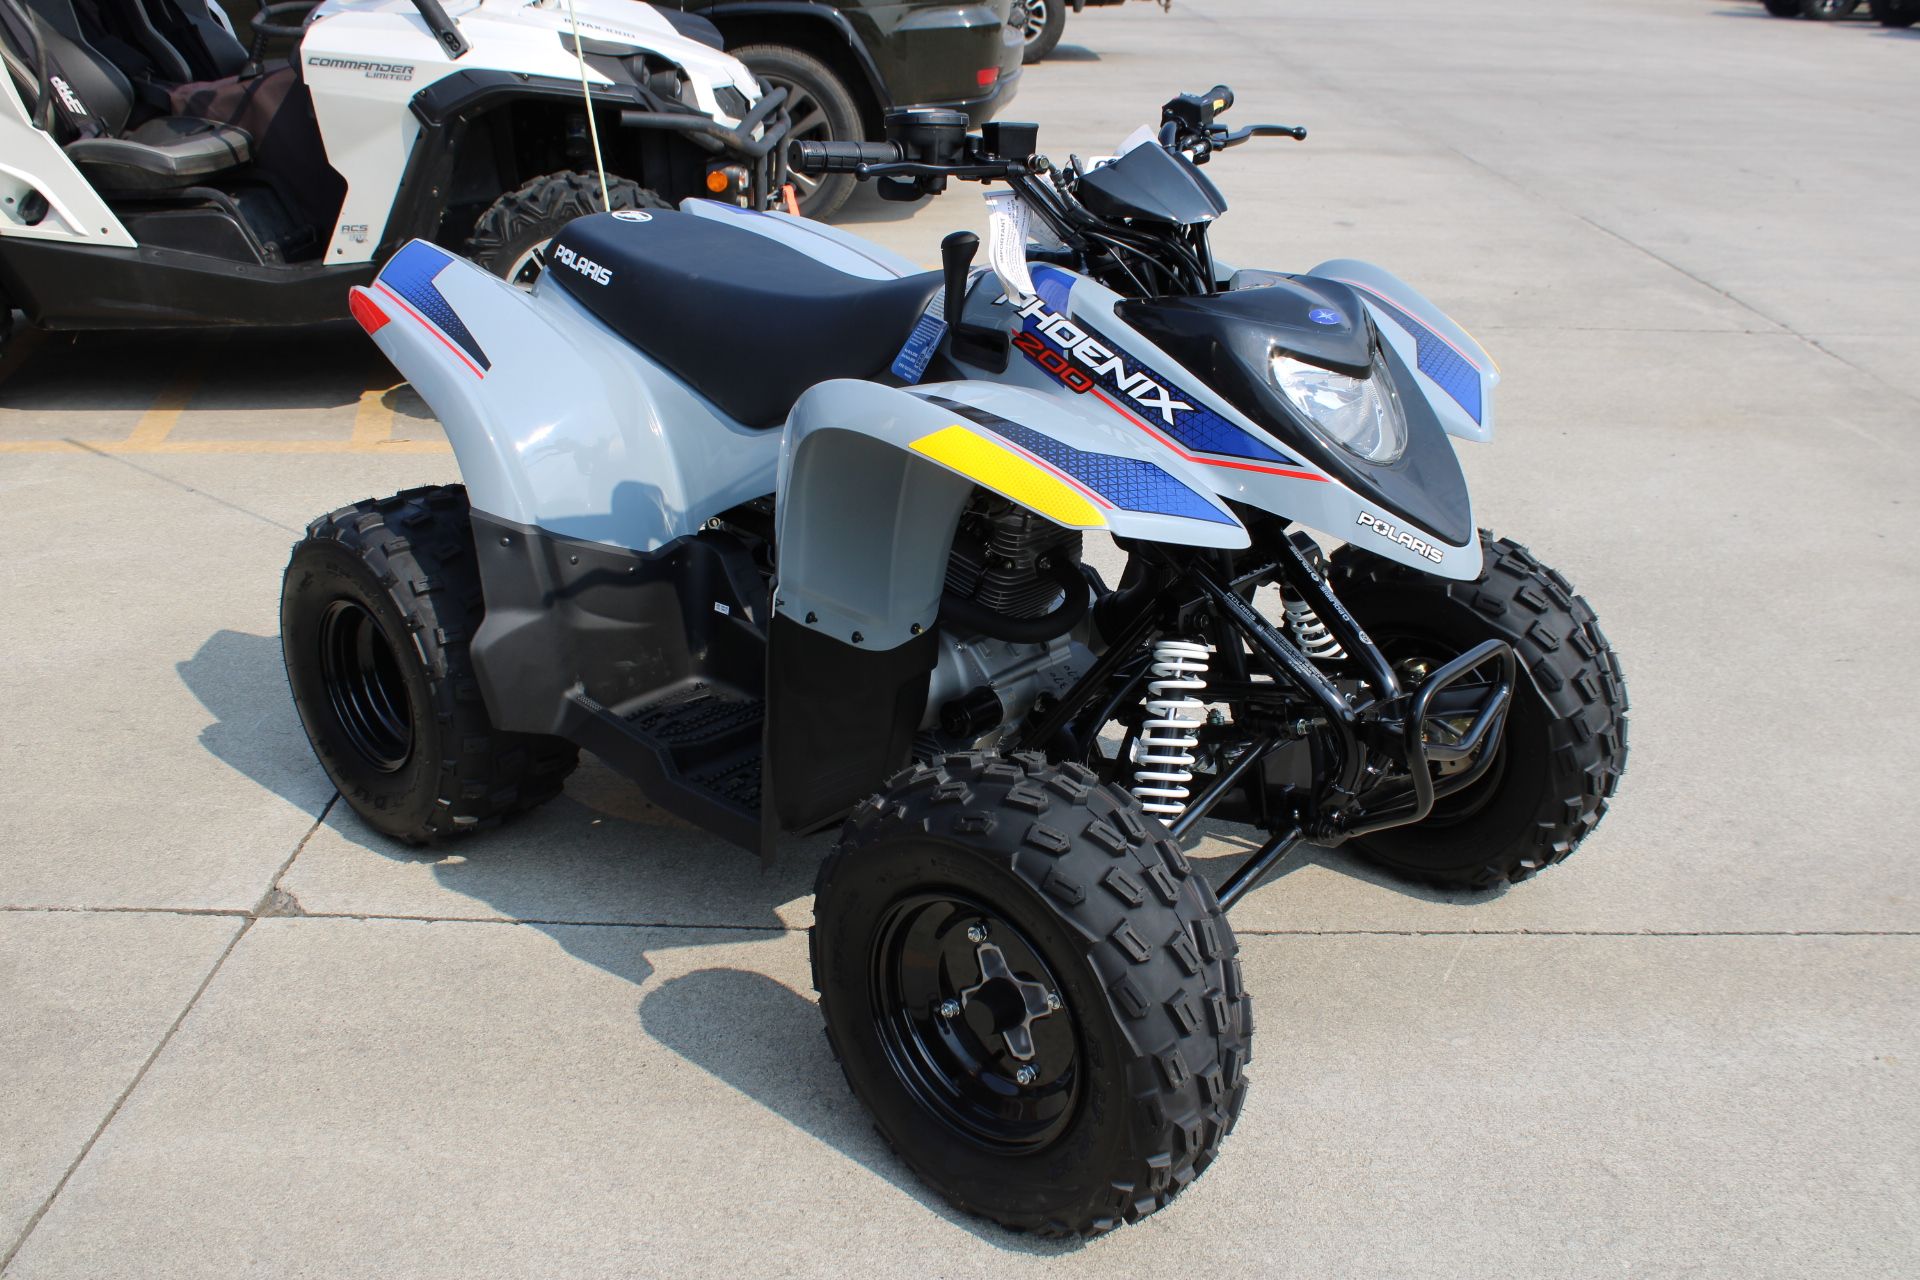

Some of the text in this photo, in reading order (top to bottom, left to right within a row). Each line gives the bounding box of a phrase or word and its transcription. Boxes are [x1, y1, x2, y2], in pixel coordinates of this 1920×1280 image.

[308, 57, 415, 74] COMMANDER
[365, 71, 413, 81] LIMITED
[341, 224, 368, 233] ACS
[554, 244, 613, 286] POLARIS
[1013, 333, 1093, 392] 200
[1356, 511, 1444, 564] POLARIS
[1226, 591, 1257, 621] POLARIS
